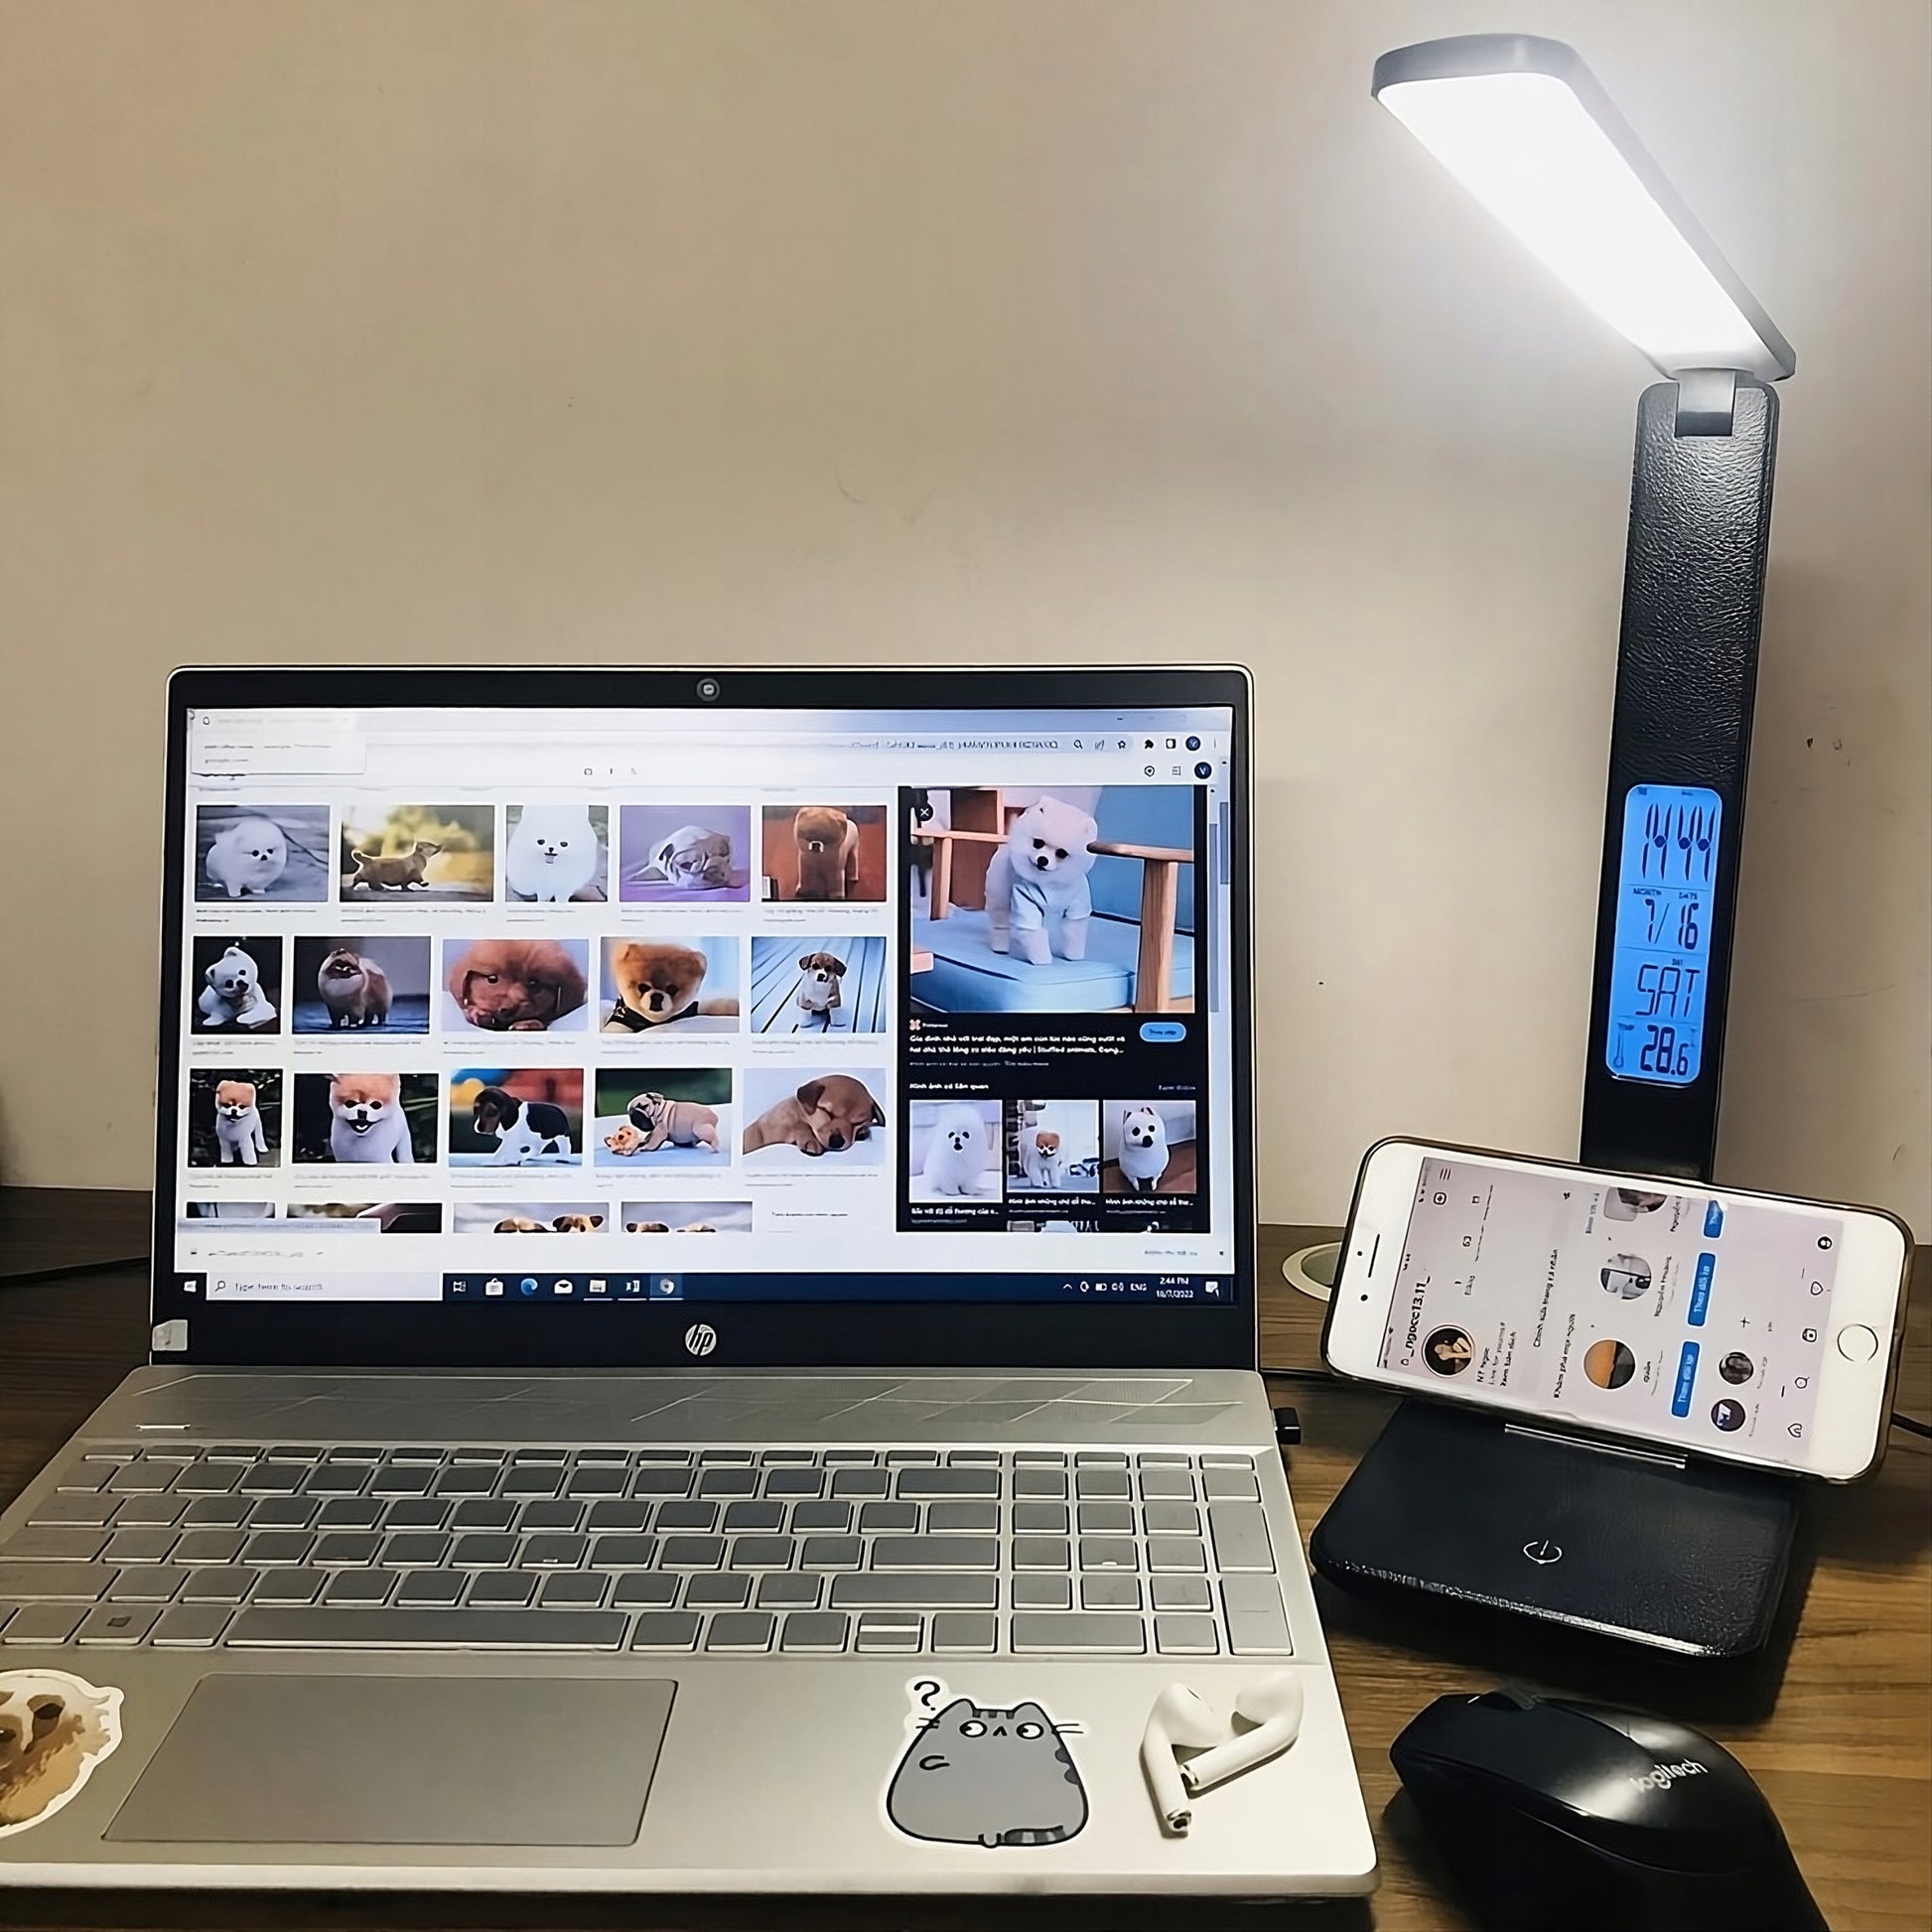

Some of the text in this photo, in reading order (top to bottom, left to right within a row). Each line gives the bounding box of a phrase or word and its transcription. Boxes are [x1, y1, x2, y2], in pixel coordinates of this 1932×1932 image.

[1635, 963, 1701, 1018] SAT
[1640, 1024, 1690, 1076] 28.6
[1629, 1757, 1709, 1794] logitech
